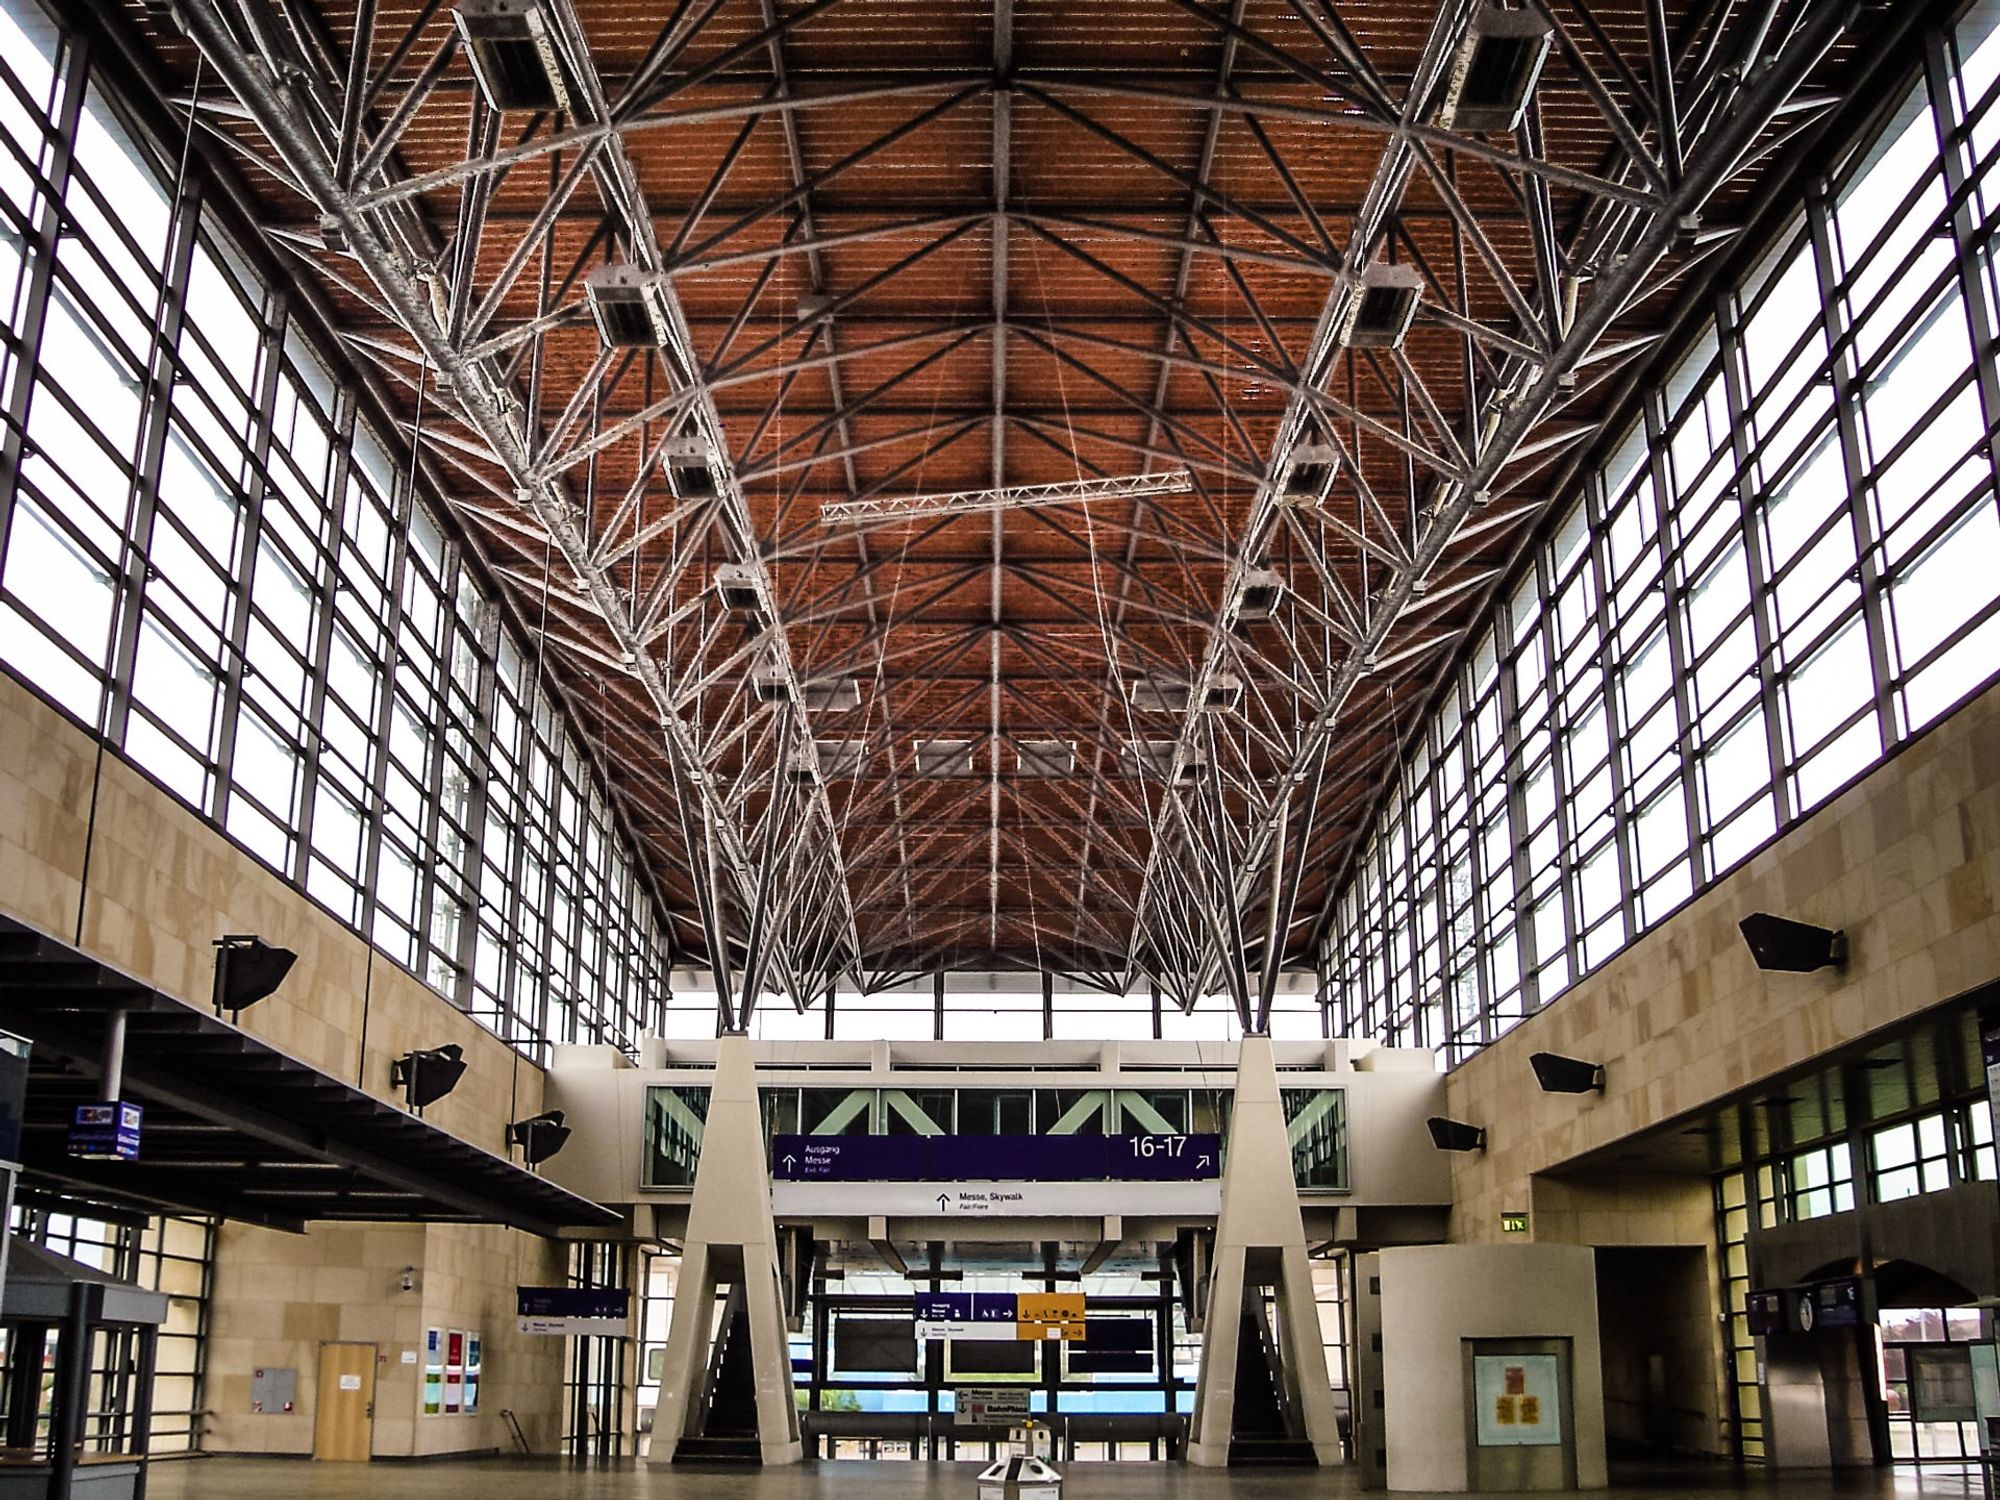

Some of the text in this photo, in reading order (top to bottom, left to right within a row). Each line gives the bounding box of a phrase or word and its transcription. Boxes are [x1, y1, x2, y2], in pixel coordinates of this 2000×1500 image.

[805, 1145, 840, 1155] Ausgang
[1129, 1136, 1187, 1157] 16-17
[805, 1156, 831, 1164] Messe
[960, 1192, 1023, 1202] Messe, Skywalk
